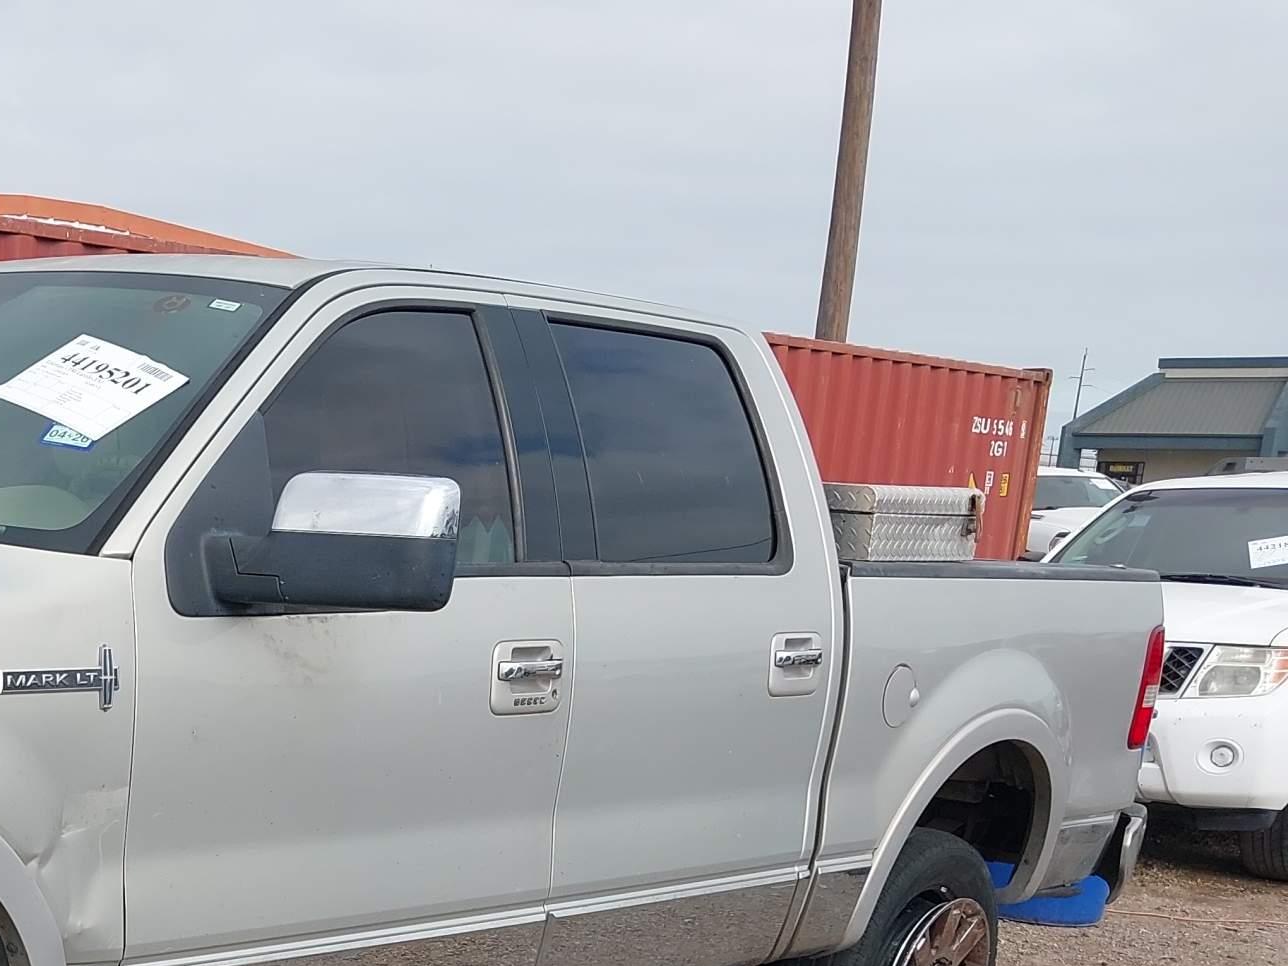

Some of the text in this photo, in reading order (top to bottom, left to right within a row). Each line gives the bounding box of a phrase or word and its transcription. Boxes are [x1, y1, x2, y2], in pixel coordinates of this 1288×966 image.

[60, 352, 152, 395] 44195201
[6, 672, 99, 687] MARK LT
